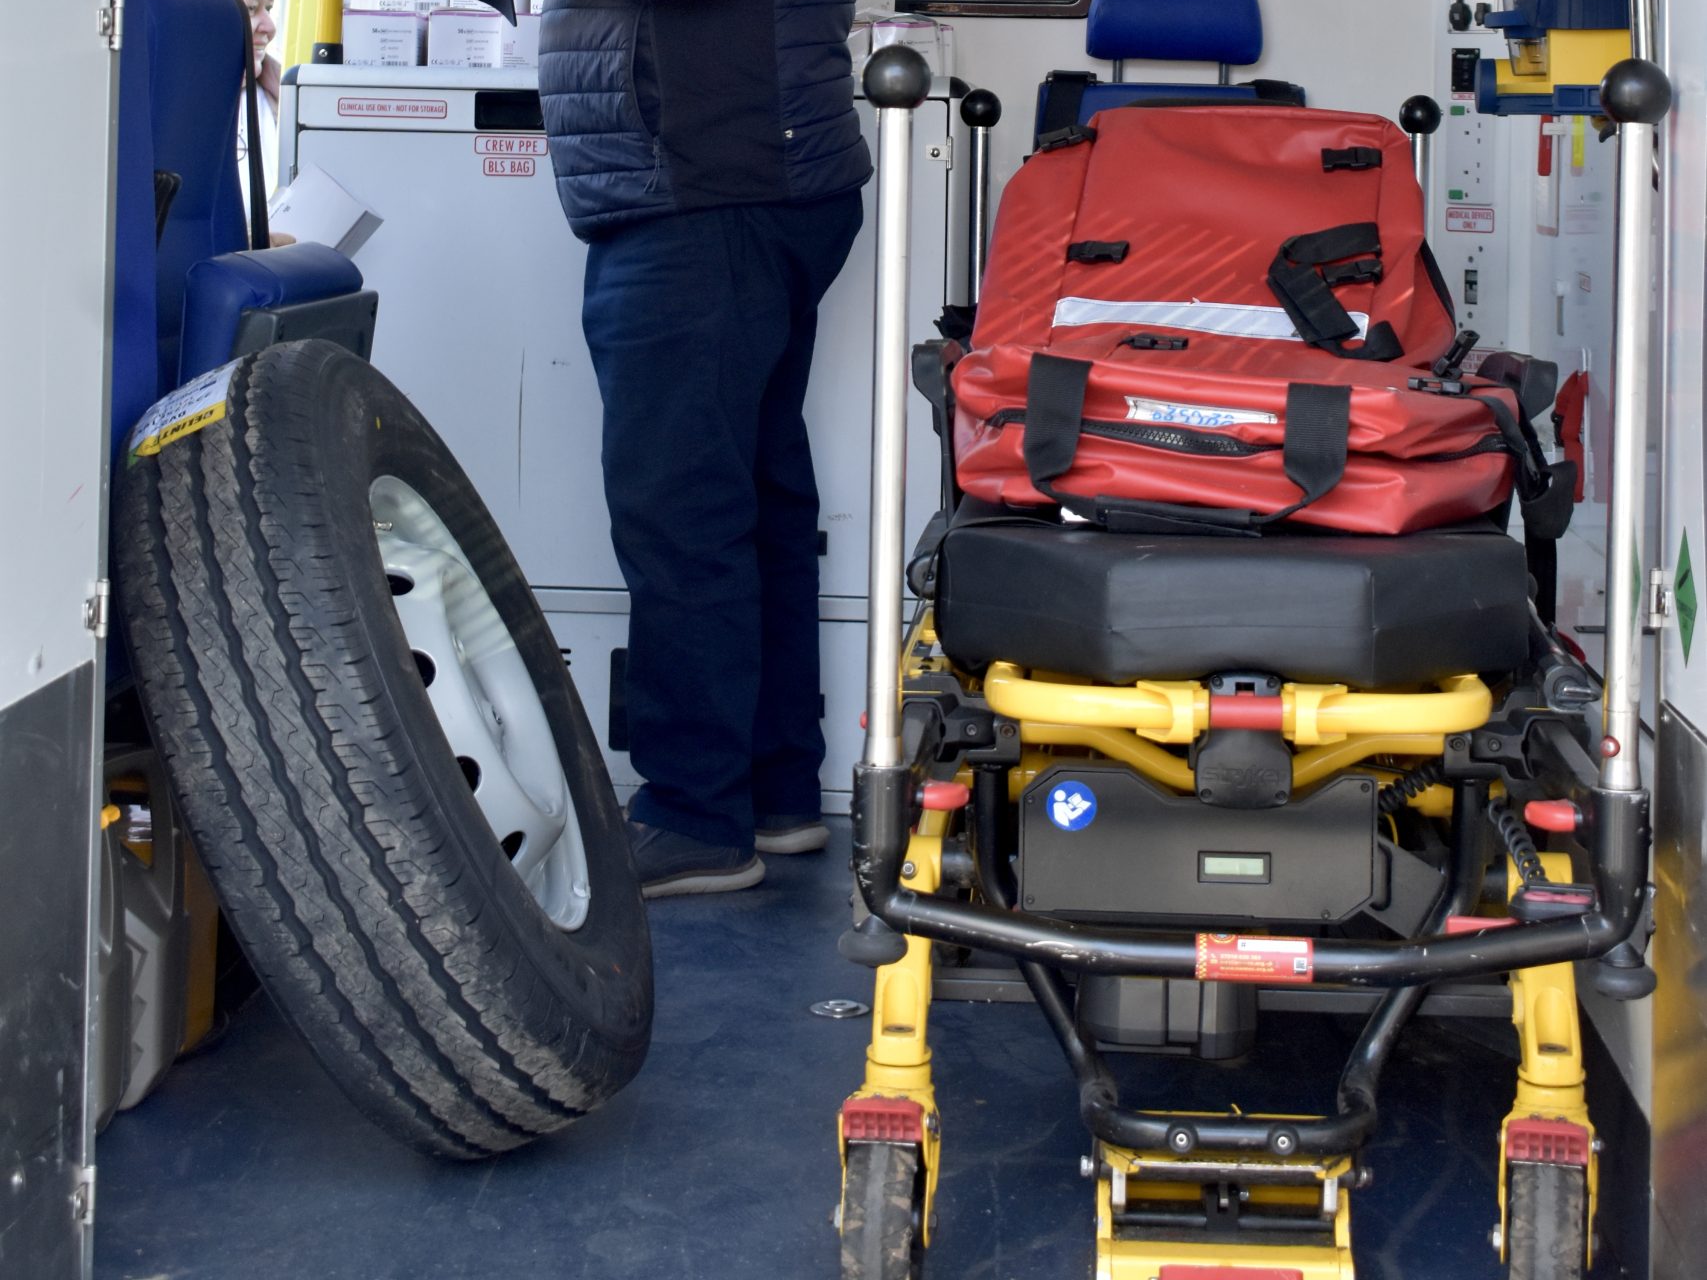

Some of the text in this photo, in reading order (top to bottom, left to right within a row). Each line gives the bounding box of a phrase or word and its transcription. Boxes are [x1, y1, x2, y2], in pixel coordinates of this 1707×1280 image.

[340, 103, 364, 111] CLINICAL
[366, 103, 375, 111] USE
[376, 104, 391, 112] ONLY
[395, 104, 407, 112] NOT
[420, 105, 444, 113] STORAGE
[486, 139, 538, 152] CREW PPE
[488, 160, 530, 173] BLS BAG
[1448, 210, 1492, 220] MEDICAL DEVICES
[1462, 220, 1477, 229] ONLY
